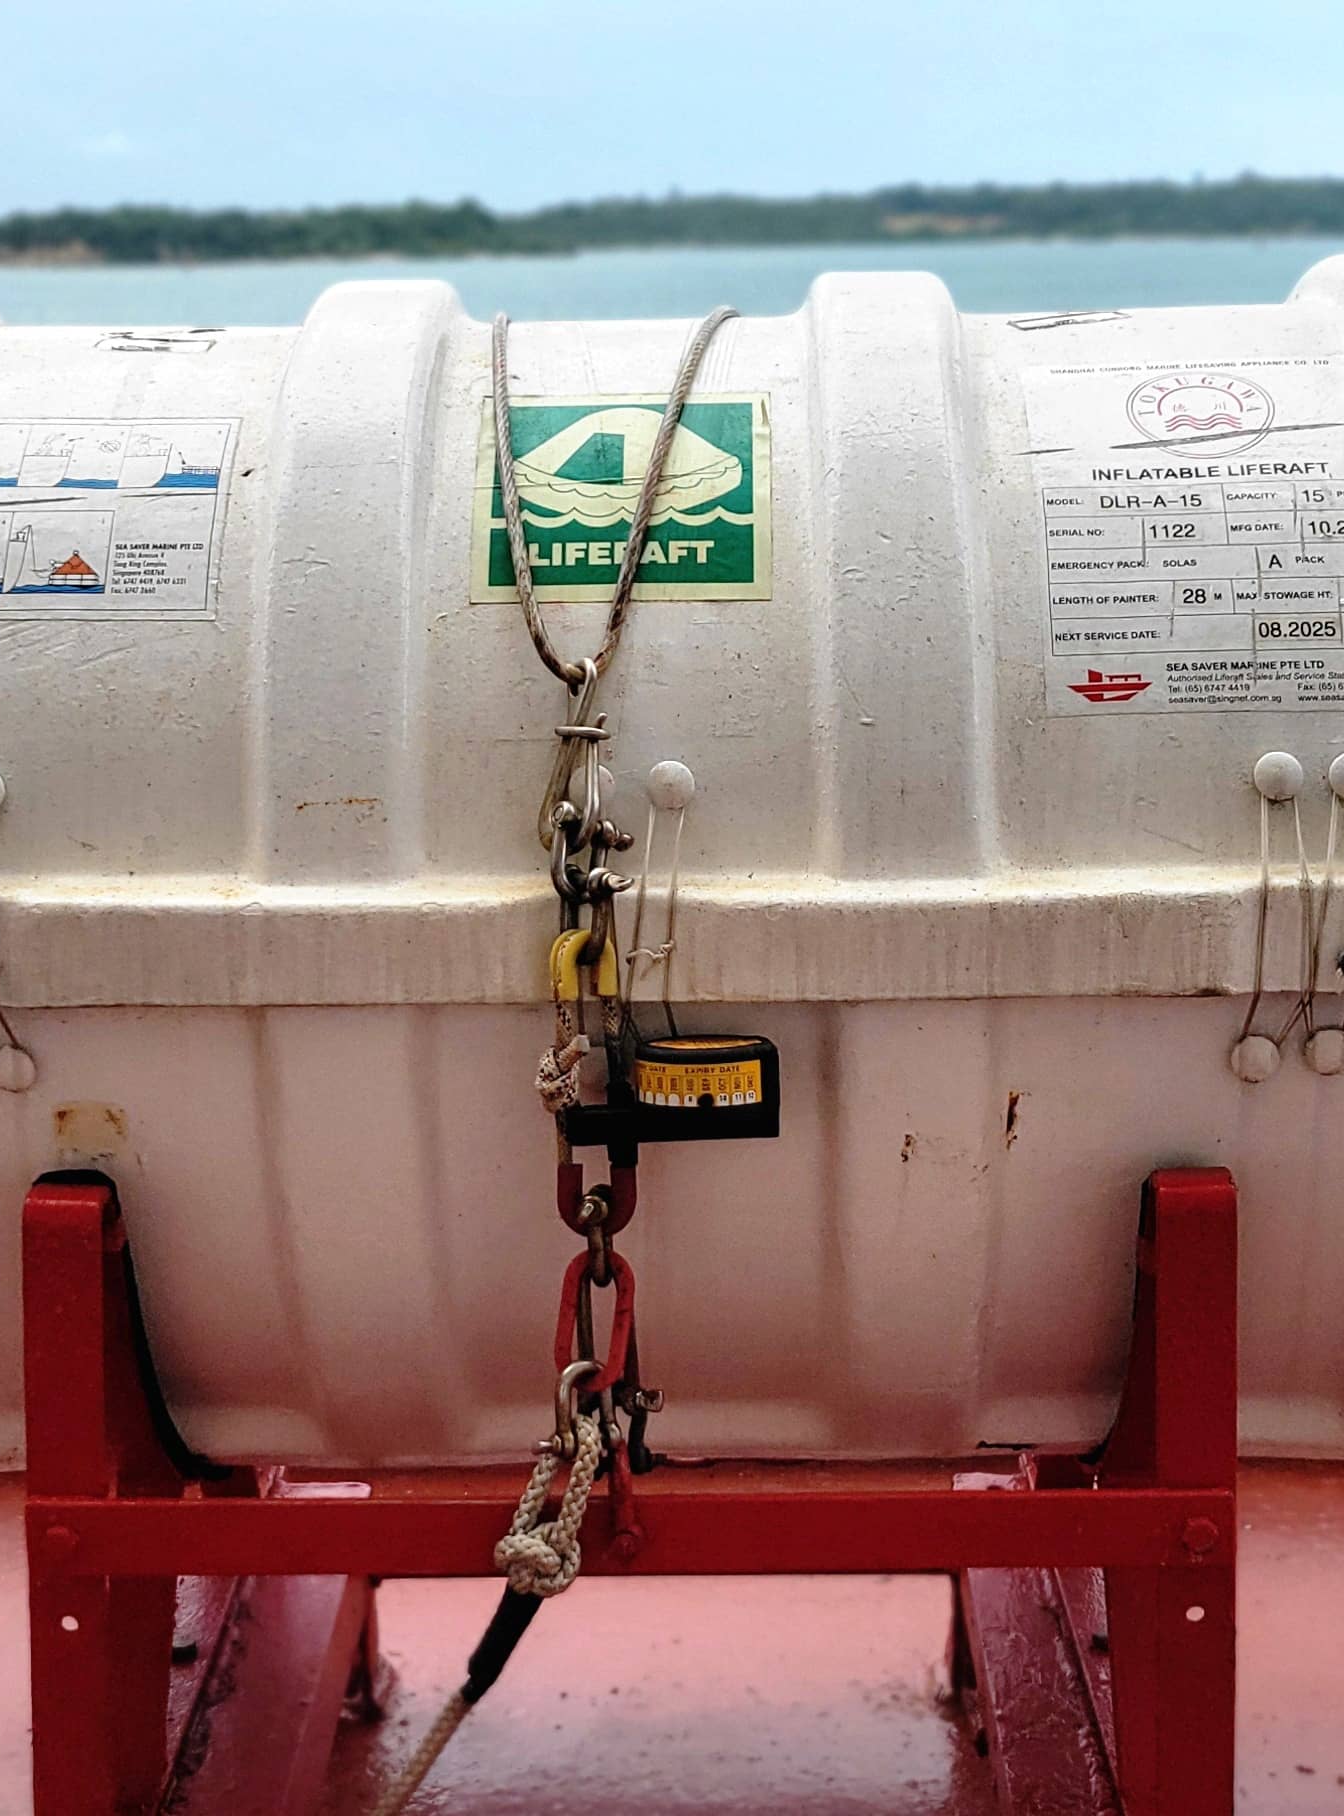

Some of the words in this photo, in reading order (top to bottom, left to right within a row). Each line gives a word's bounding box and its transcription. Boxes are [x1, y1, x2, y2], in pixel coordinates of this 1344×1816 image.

[1092, 466, 1221, 481] INFLATABLE
[1228, 463, 1328, 477] LIFERAFT
[1302, 490, 1325, 502] 15
[1100, 494, 1202, 509] DLR-A-15
[1049, 529, 1084, 537] SERIAL
[1087, 528, 1105, 536] NO:
[1149, 523, 1196, 539] 1122
[1230, 524, 1252, 532] MFG
[1255, 523, 1284, 531] DATE:
[1051, 561, 1114, 570] EMERGENCY
[1162, 559, 1197, 567] SOLAS
[1268, 554, 1283, 569] A
[1295, 556, 1325, 564] PACK
[1052, 596, 1094, 605] LENGTH
[1096, 595, 1112, 604] OF
[1113, 594, 1159, 604] PAINTER:
[1182, 588, 1206, 604] 28
[1263, 591, 1315, 600] STOWAGE
[1055, 633, 1082, 641] NEXT
[1084, 631, 1128, 641] SERVICE
[1131, 631, 1160, 639] DATE:
[1258, 621, 1336, 638] 08.2025
[1166, 662, 1189, 672] SEA
[1191, 662, 1228, 671] SAVER
[1280, 661, 1301, 669] PTE
[1304, 660, 1325, 669] LTD
[1294, 672, 1325, 680] Service
[1185, 684, 1203, 693] (65)
[1204, 684, 1226, 692] 6747
[1319, 682, 1336, 691] (65)
[720, 1065, 740, 1074] DATE
